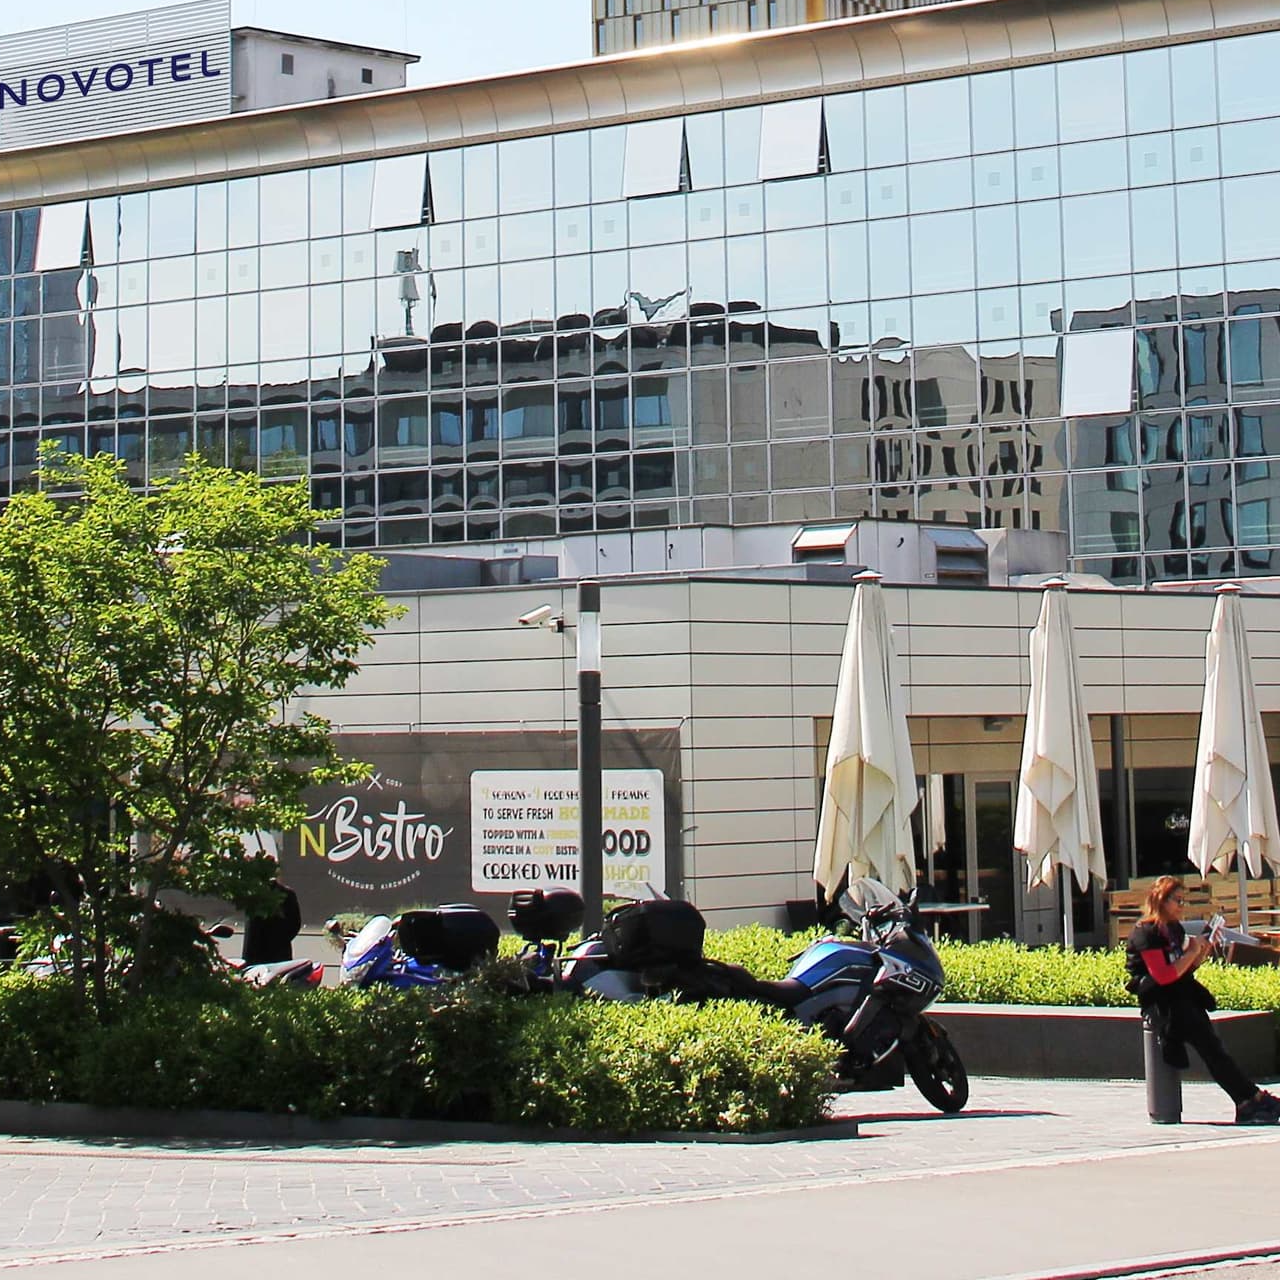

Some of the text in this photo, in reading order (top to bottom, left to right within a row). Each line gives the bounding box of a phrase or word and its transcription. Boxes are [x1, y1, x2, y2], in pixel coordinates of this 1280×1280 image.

[491, 790, 526, 800] SEASONS
[543, 790, 565, 800] FOOD
[611, 790, 650, 800] PROMISE
[483, 808, 494, 820] TO
[497, 808, 523, 820] SERVE
[526, 808, 554, 820] FRESH
[483, 829, 515, 840] TOPPED
[516, 829, 538, 840] WITH
[539, 829, 546, 840] A
[601, 829, 651, 856] OOD
[483, 845, 515, 855] SERVICE
[515, 845, 525, 855] IN
[526, 845, 532, 855] A
[556, 845, 579, 856] BISTR
[483, 863, 540, 880] COOKED
[380, 869, 421, 890] KIRCHBERG
